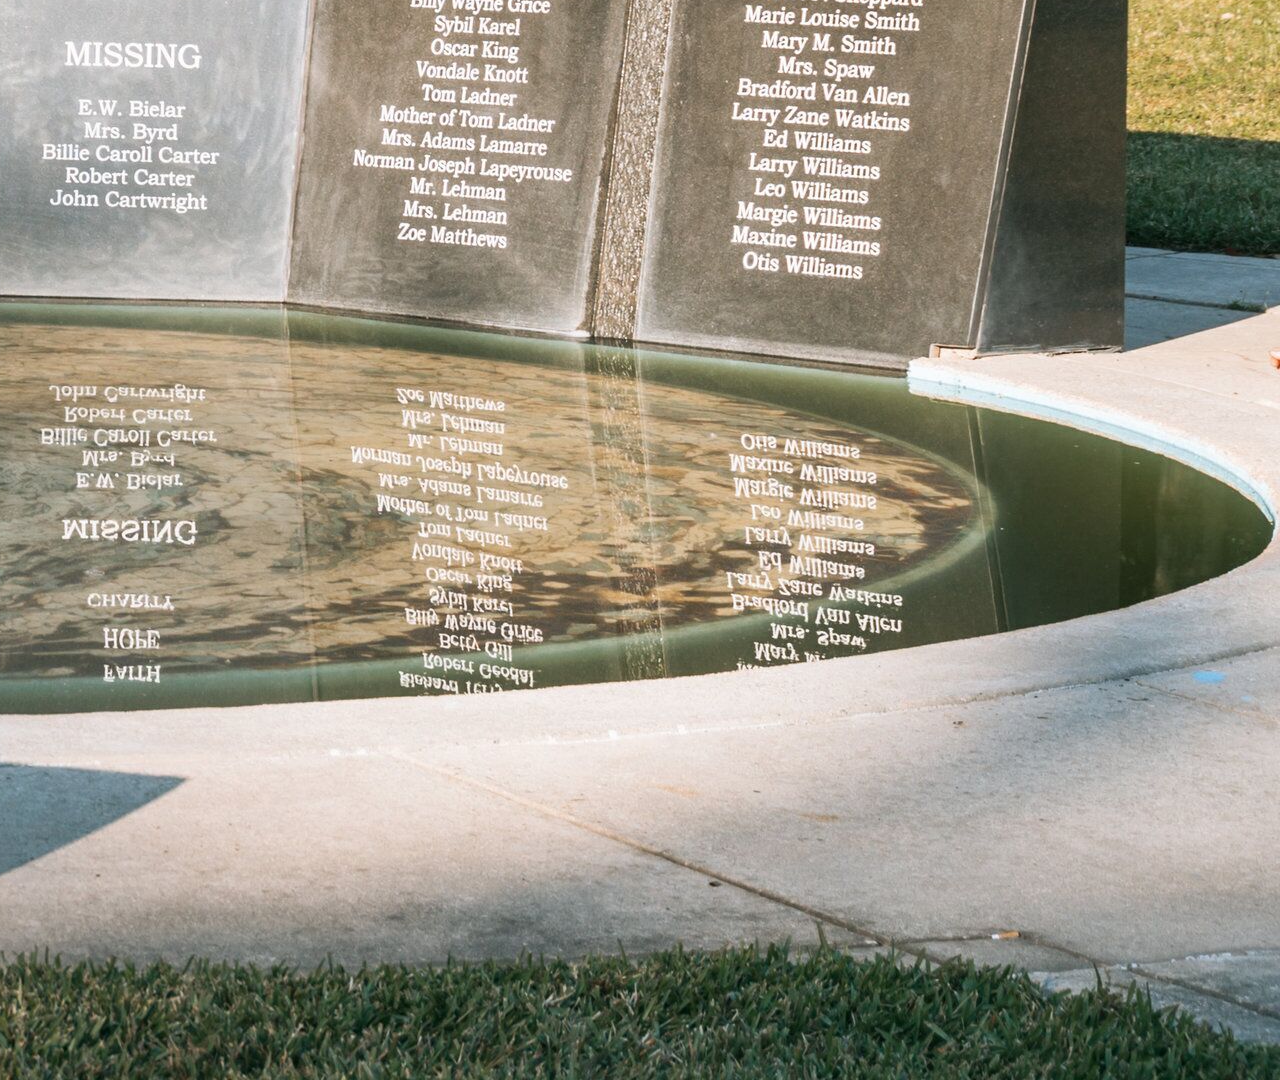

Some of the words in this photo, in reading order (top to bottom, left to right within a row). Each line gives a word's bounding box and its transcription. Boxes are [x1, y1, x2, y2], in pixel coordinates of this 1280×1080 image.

[744, 5, 795, 25] Marie
[800, 8, 860, 29] Louise
[864, 11, 920, 31] Smith
[64, 41, 202, 71] MISSING
[737, 78, 816, 100] Bradford
[822, 83, 858, 103] Van
[862, 86, 910, 106] Allen
[78, 99, 122, 116] E.W.
[129, 100, 186, 119] Bielar
[380, 105, 436, 124] Mother
[439, 109, 458, 126] of
[459, 110, 493, 128] Tom
[498, 113, 555, 133] Ladner
[731, 102, 781, 127] Larry
[783, 106, 829, 126] Zane
[835, 109, 911, 132] Watkins
[84, 121, 126, 139] Mrs.
[133, 124, 178, 146] Byrd
[41, 144, 91, 161] Billie
[95, 146, 153, 163] Caroll
[158, 147, 219, 166] Carter
[353, 149, 415, 170] Norman
[418, 155, 475, 178] Joseph
[479, 159, 572, 184] Lapeyrouse
[65, 168, 129, 185] Robert
[134, 169, 195, 187] Carter
[50, 189, 100, 208] John
[104, 189, 208, 215] Cartwright
[743, 251, 779, 272] Otis
[785, 255, 863, 279] Williams
